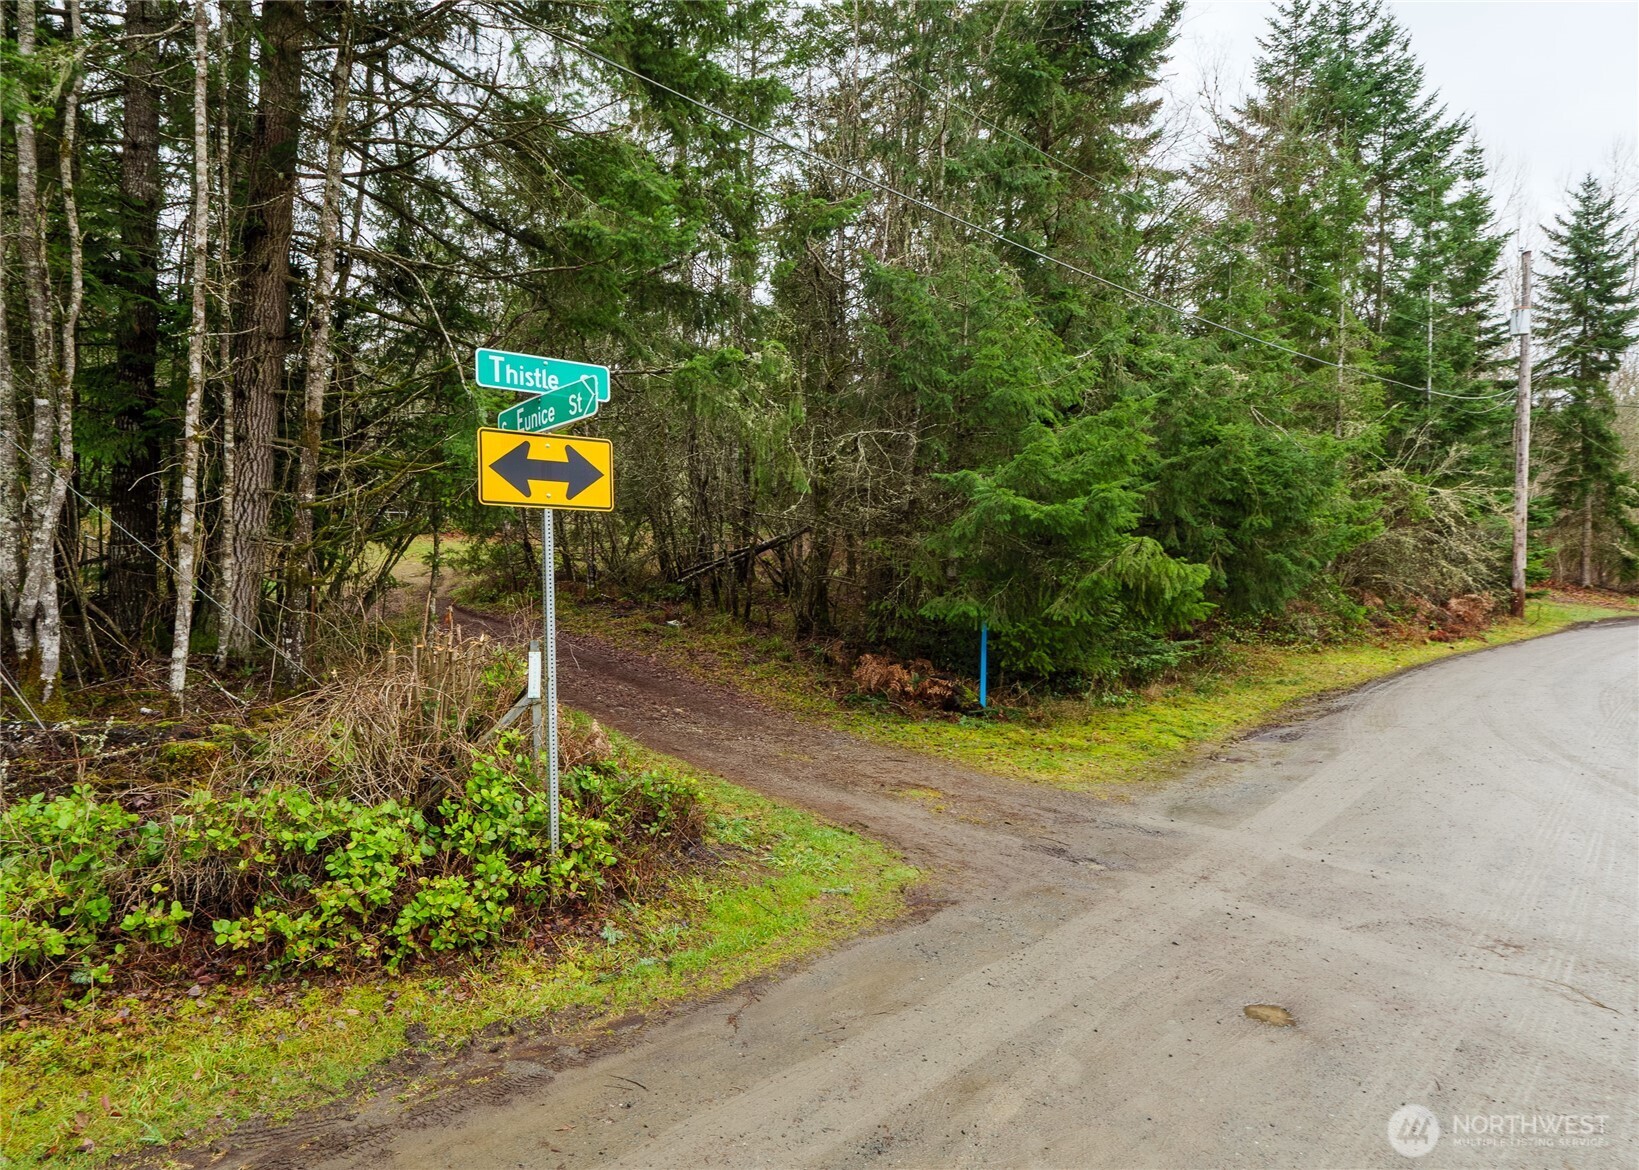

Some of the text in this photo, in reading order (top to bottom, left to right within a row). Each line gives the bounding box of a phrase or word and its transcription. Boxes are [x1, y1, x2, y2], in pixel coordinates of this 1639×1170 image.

[489, 355, 559, 390] Thistle
[517, 393, 583, 433] Eunice St
